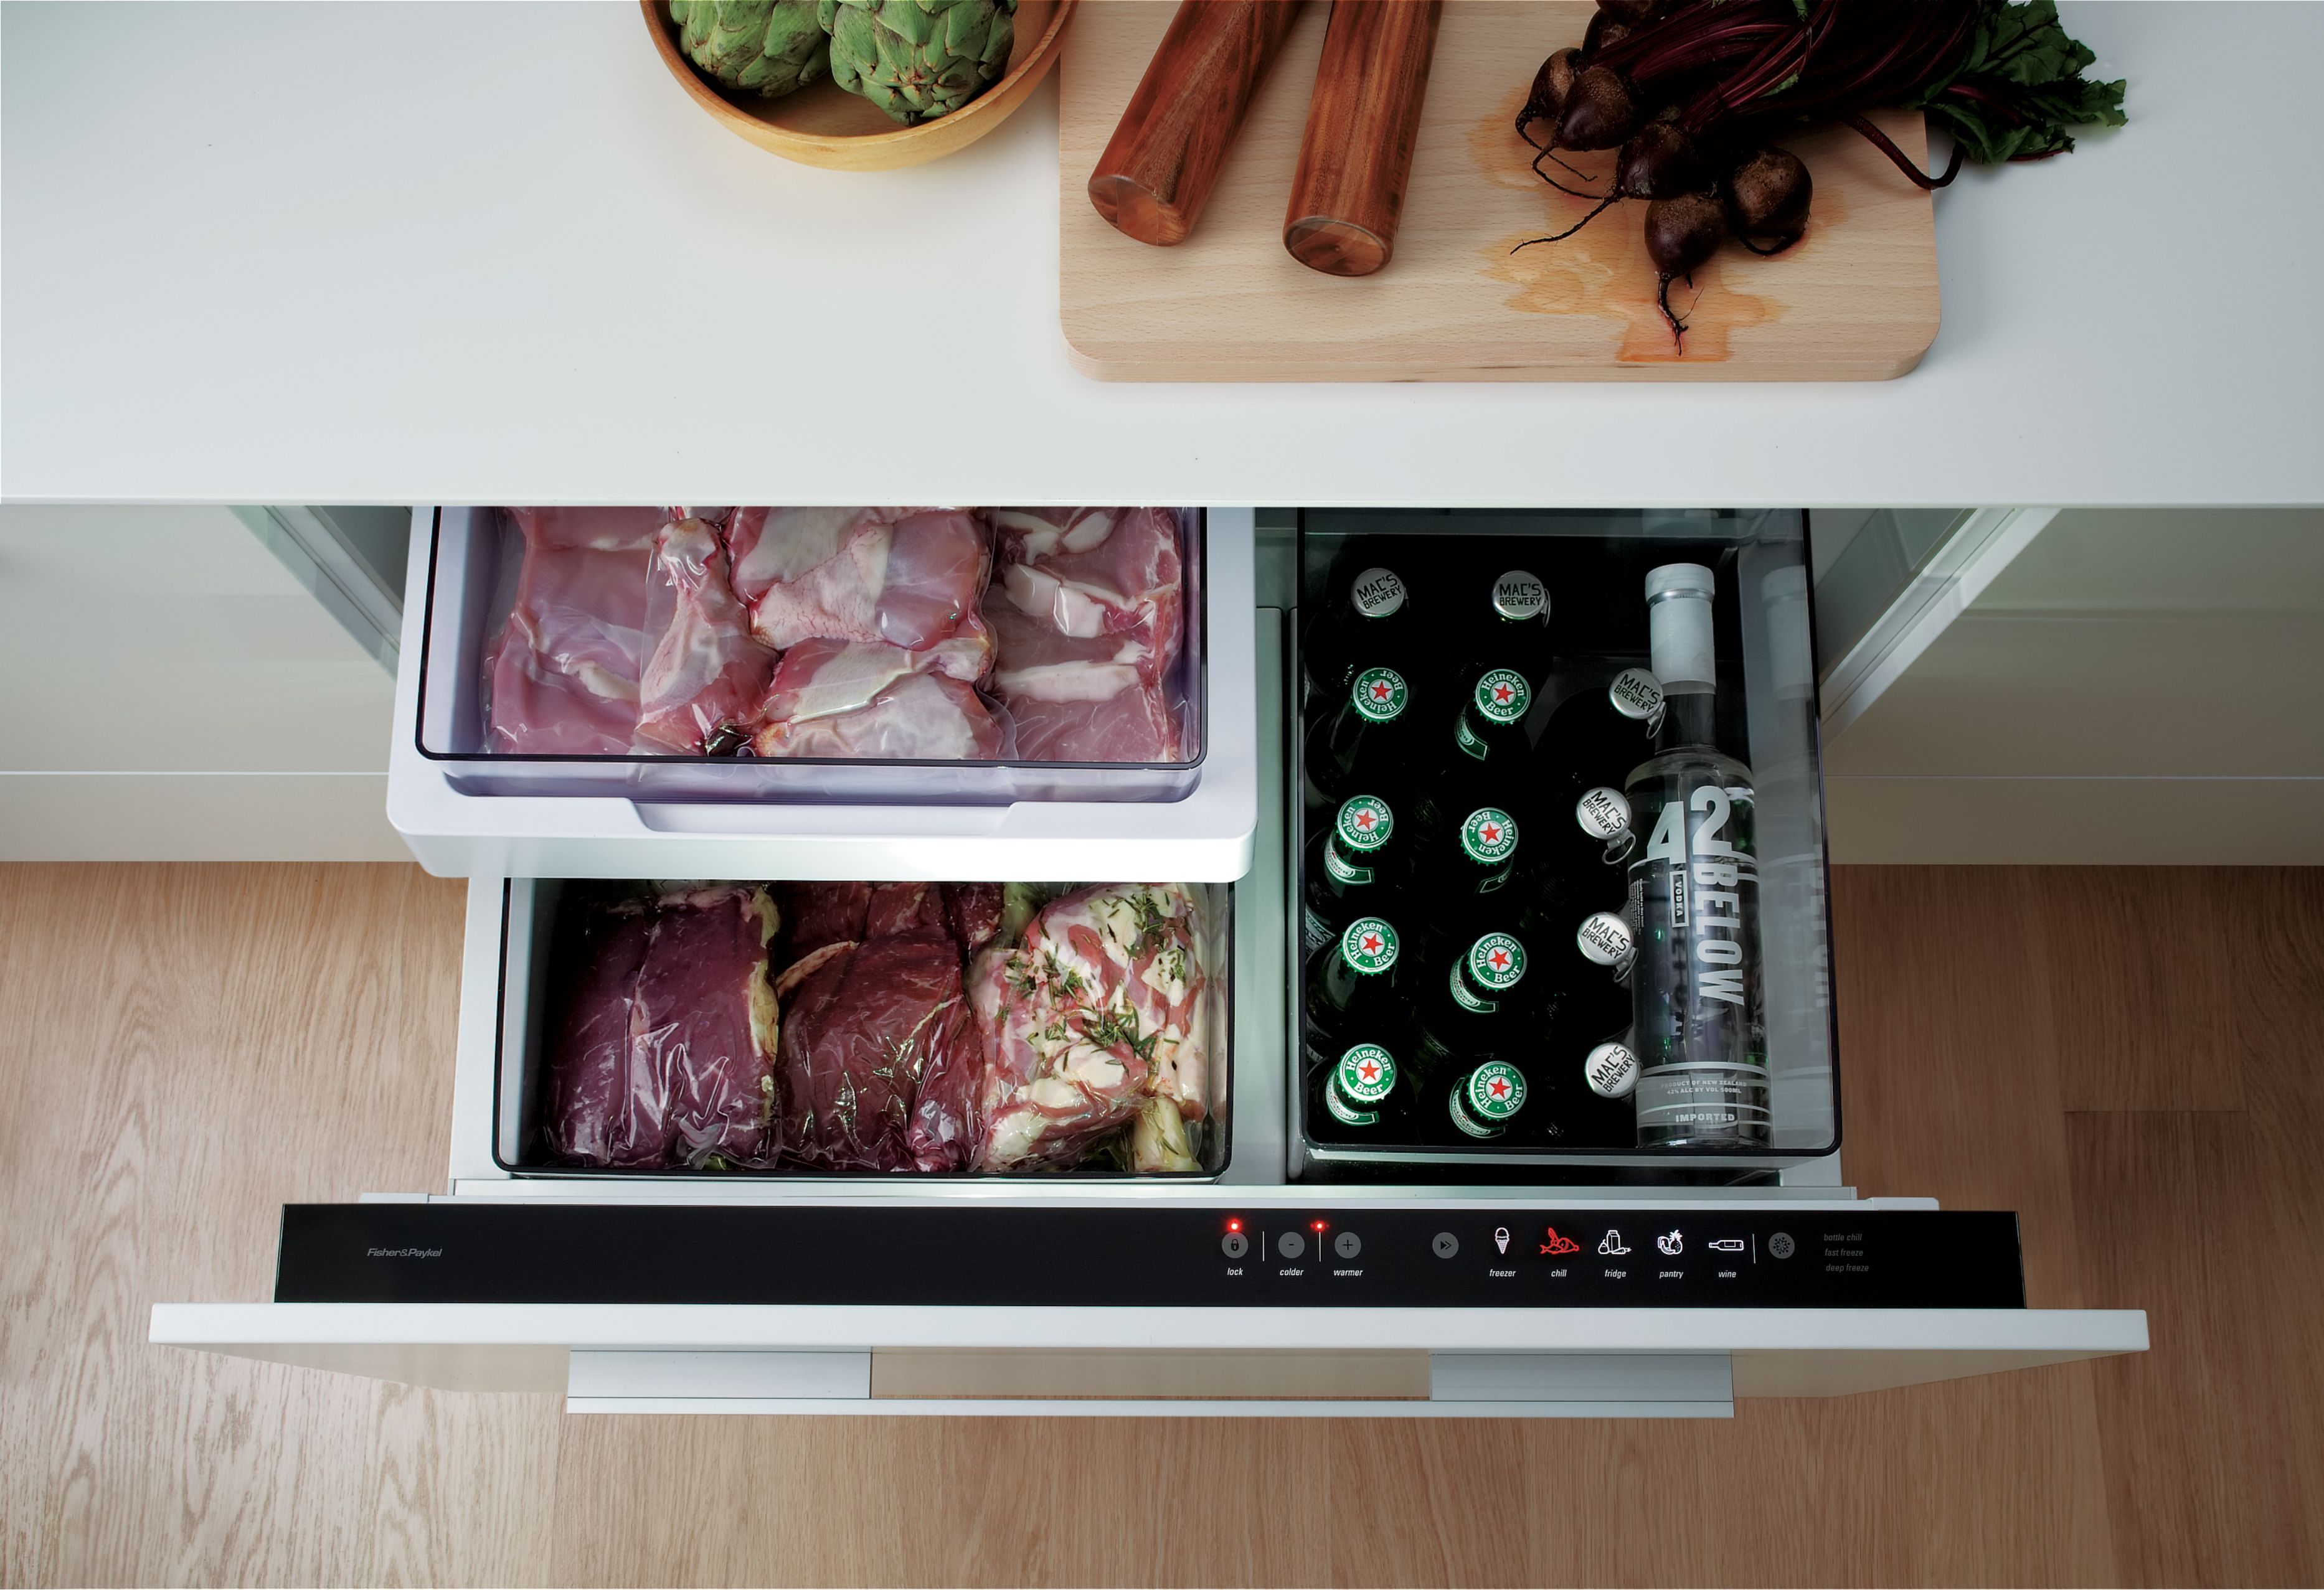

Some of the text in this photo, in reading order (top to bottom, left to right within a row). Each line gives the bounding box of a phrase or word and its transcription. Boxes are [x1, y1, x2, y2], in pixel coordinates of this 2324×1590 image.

[1356, 573, 1398, 601] MAC'S
[1362, 585, 1402, 609] BREWERY
[1499, 583, 1541, 597] MAC'S
[1499, 596, 1542, 606] BREWERY
[1380, 669, 1404, 692] Beer
[1481, 672, 1526, 697] Heineken
[1619, 673, 1660, 705] MAC'S
[1359, 680, 1397, 714] Heineken
[1614, 684, 1654, 713] BREWERY
[1486, 701, 1514, 717] Beer
[1367, 799, 1389, 822] Beer
[1582, 798, 1616, 835] BREWERY
[1590, 790, 1627, 830] MAC'S
[1343, 805, 1381, 842] Heineken
[1468, 811, 1491, 834] Beer
[1646, 785, 1732, 864] 42
[1478, 819, 1514, 855] Heineken
[1675, 880, 1683, 917] VODKA
[1349, 922, 1383, 961] Heineken
[1582, 927, 1622, 960] BREWERY
[1588, 916, 1630, 953] MAC'S
[1693, 863, 1744, 1006] BELOW
[1372, 942, 1396, 967] Beer
[1475, 936, 1518, 969] Heineken
[1494, 964, 1521, 983] Beer
[1345, 1048, 1392, 1071] Heineken
[1590, 1045, 1628, 1086] MAC'S
[1602, 1054, 1636, 1093] BREWERY
[1661, 1081, 1690, 1089] PRODUCT
[1353, 1081, 1383, 1096] Beer
[1481, 1066, 1508, 1109] Heineken
[1504, 1083, 1523, 1111] Beer
[1675, 1113, 1735, 1122] IMPORTED
[1823, 1233, 1863, 1241] bottle chill
[367, 1248, 443, 1259] Fisher&Paykel
[1825, 1248, 1864, 1256] fast freeze
[1227, 1267, 1244, 1276] lock
[1279, 1267, 1304, 1276] colder
[1333, 1268, 1364, 1276] warmer
[1489, 1269, 1516, 1277] freezer
[1551, 1269, 1567, 1277] chill
[1604, 1269, 1627, 1279] fridge
[1659, 1269, 1684, 1279] pantry
[1718, 1269, 1737, 1278] wine
[1826, 1263, 1869, 1273] deep freeze
